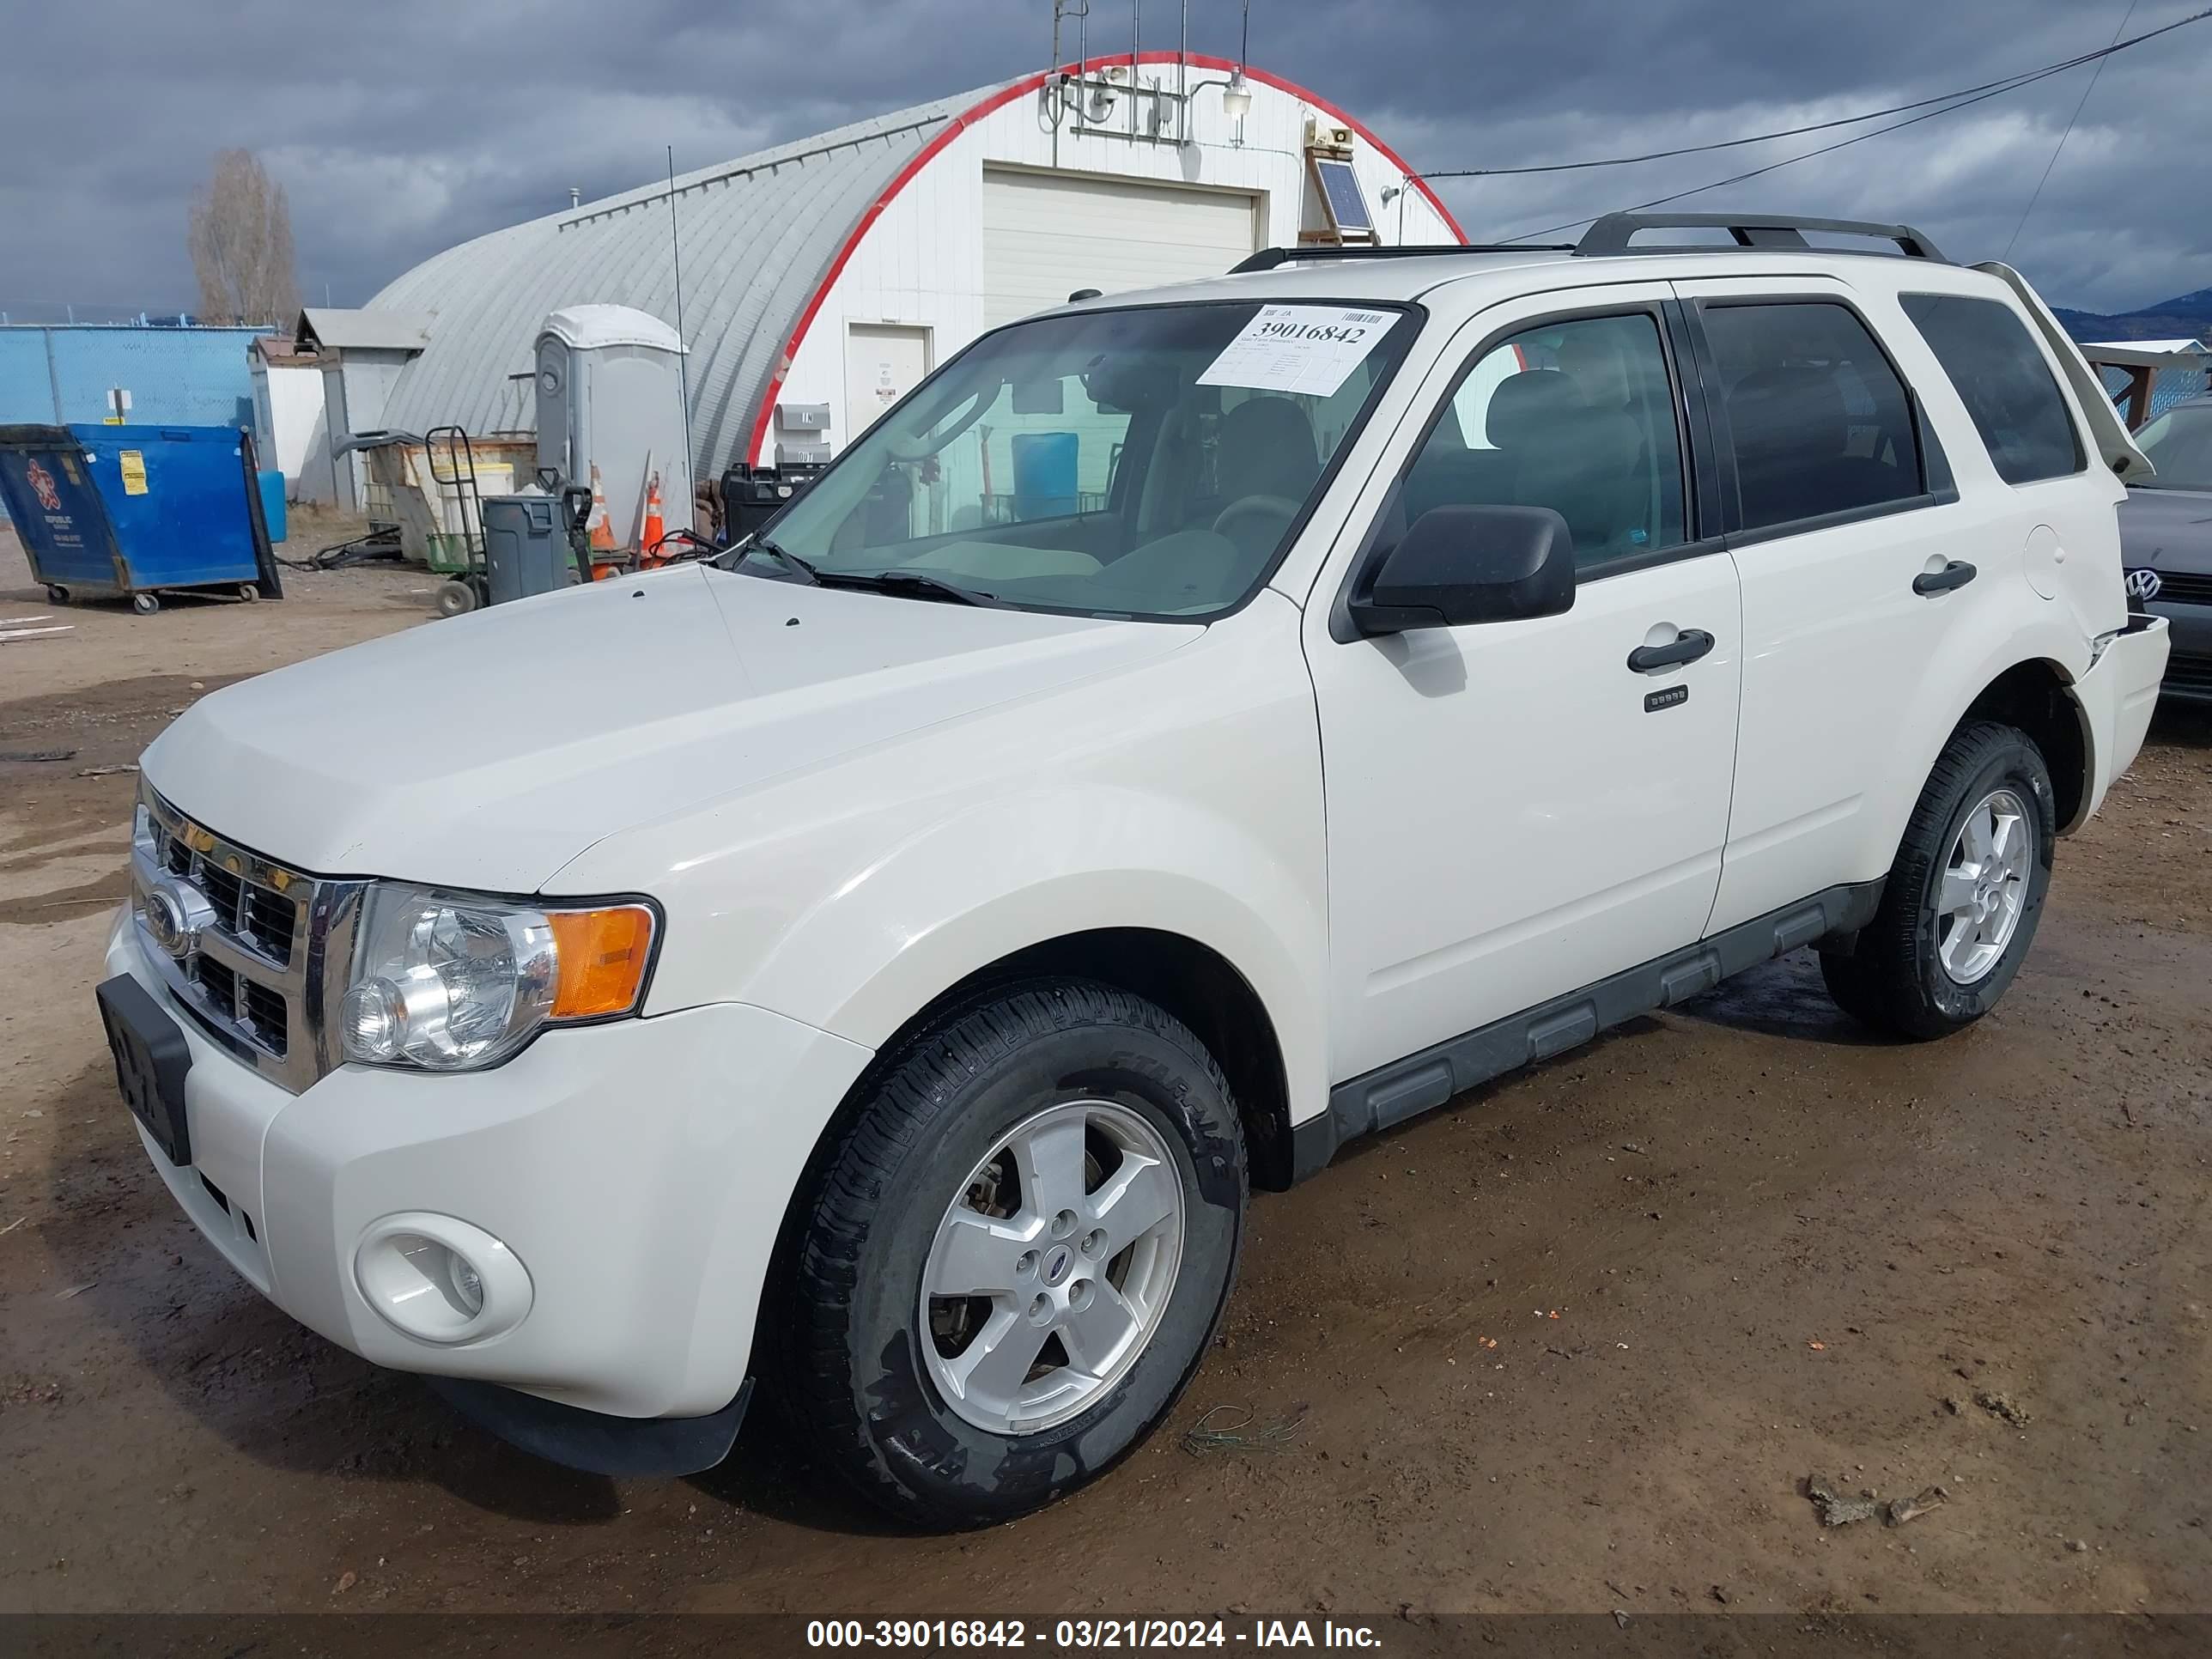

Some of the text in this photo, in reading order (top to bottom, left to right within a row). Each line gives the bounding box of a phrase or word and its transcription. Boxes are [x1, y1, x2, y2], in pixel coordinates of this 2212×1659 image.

[1253, 323, 1365, 343] 39016842
[802, 412, 813, 423] IN
[799, 452, 813, 463] OUT
